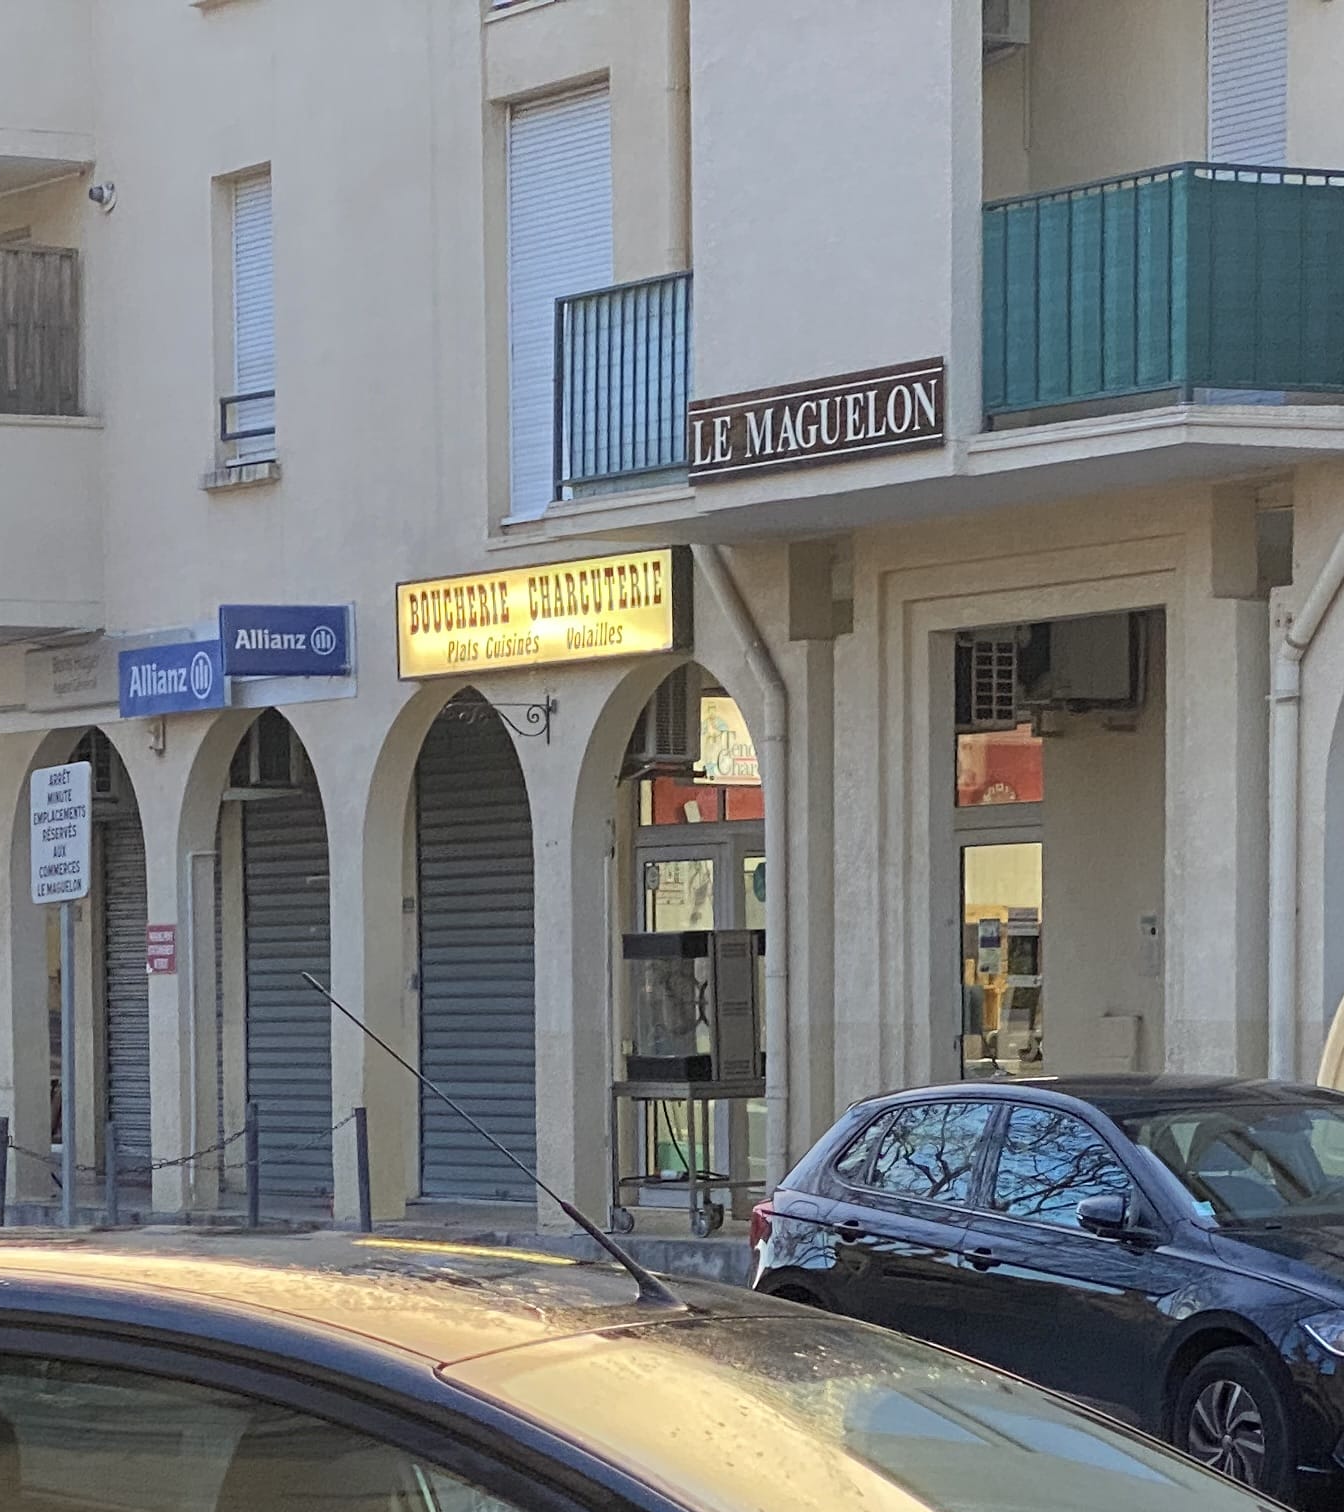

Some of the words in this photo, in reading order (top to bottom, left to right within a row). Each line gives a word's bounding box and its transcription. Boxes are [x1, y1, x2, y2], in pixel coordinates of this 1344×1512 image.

[692, 416, 732, 466] LE
[744, 379, 937, 458] MAGUELON
[409, 581, 510, 635] BOUCHERIE
[527, 560, 662, 621] CHARCUTERIE
[235, 629, 306, 650] Allianz
[447, 639, 479, 664] Plats
[485, 630, 540, 660] Cuisinés
[566, 621, 623, 650] Volailles
[129, 665, 187, 698] Allianz
[47, 789, 72, 804] MINUTE
[33, 805, 86, 825] EMPLACEMENTS
[52, 846, 66, 859] AUX
[39, 861, 81, 879] COMMERCES
[37, 883, 46, 897] LE
[46, 878, 82, 896] MAGUELON
